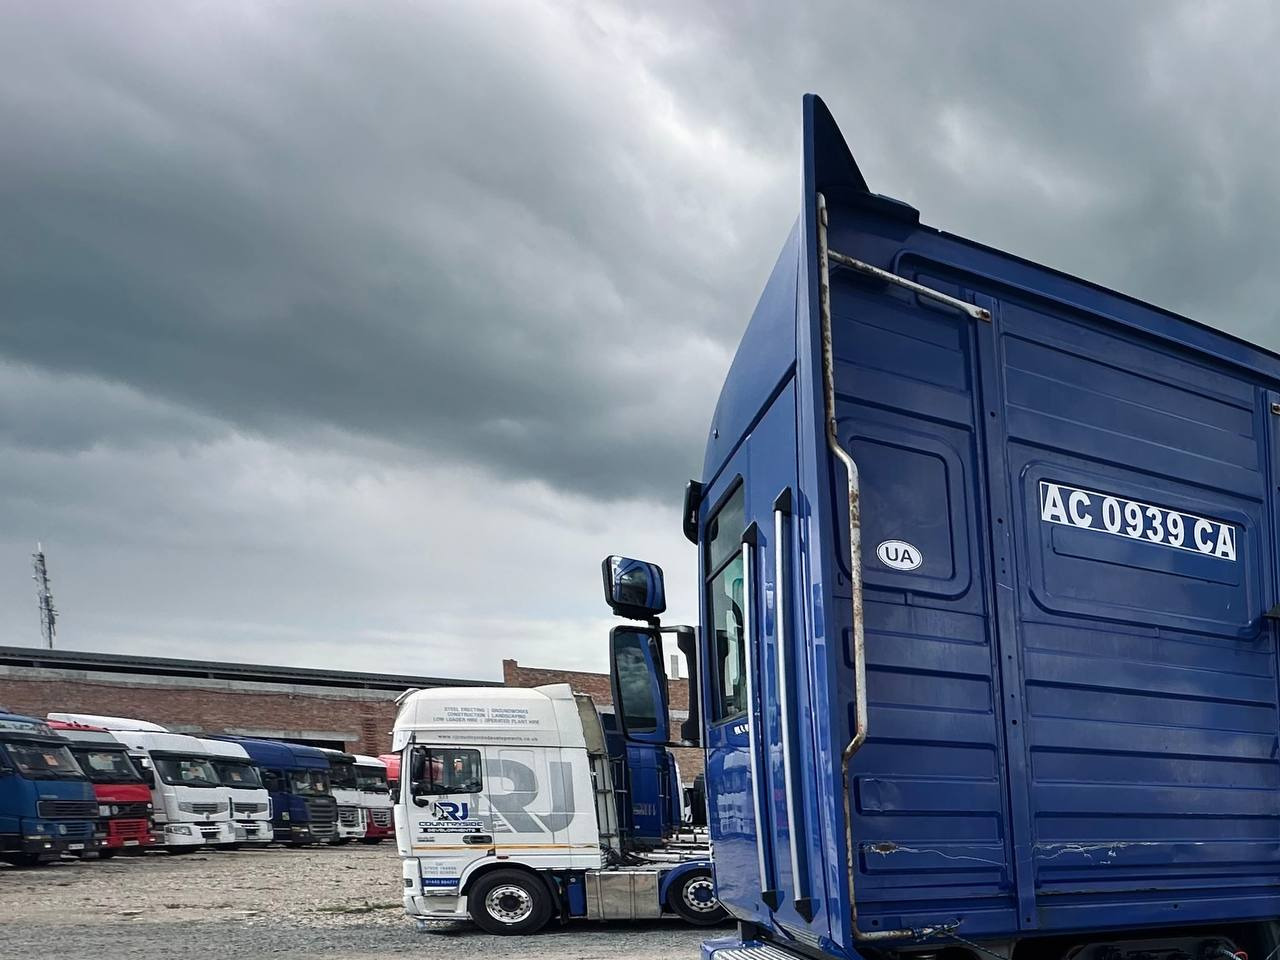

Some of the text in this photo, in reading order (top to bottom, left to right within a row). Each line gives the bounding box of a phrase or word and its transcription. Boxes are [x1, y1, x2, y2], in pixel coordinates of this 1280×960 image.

[1042, 484, 1235, 560] AC 0939 CA
[885, 546, 915, 565] UA
[438, 802, 469, 821] RJ
